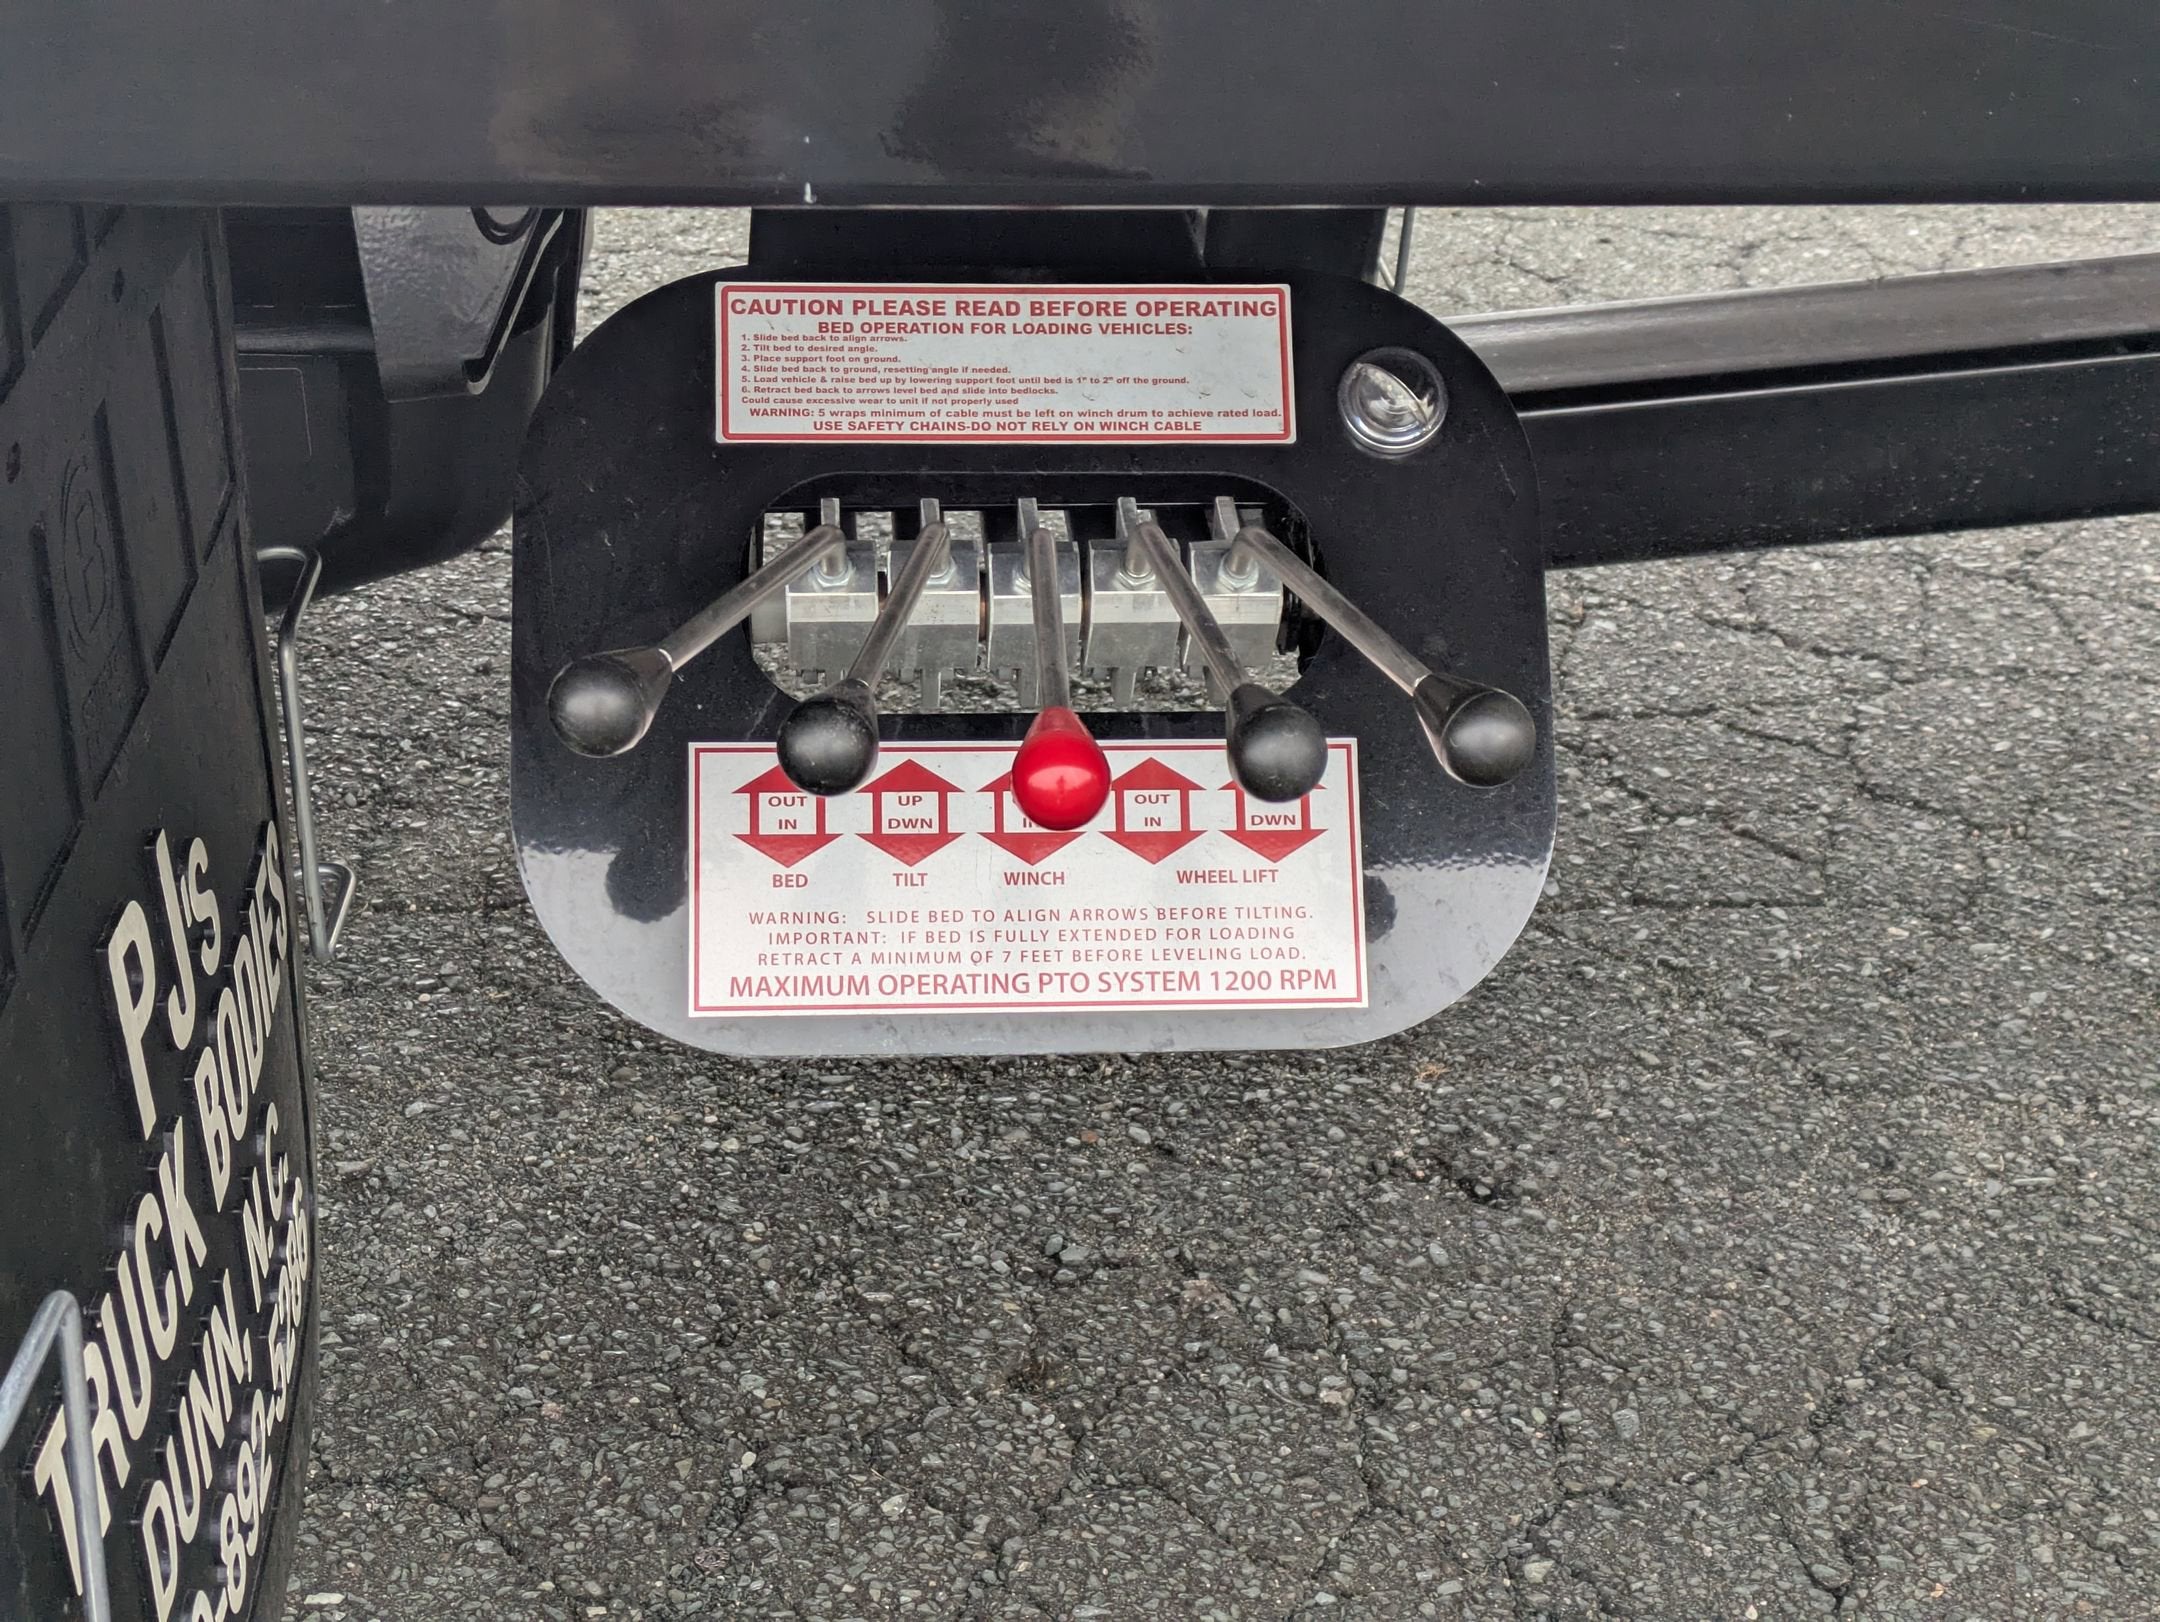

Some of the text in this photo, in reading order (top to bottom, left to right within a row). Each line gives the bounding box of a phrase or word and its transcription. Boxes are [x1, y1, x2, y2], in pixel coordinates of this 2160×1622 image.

[731, 299, 1275, 316] CAUTION PLEASE READ BEFORE OPERATING
[818, 322, 1192, 335] BED OPERATION FOR LOADING VEHICLES:
[932, 367, 958, 375] angle
[895, 377, 905, 385] by
[910, 377, 951, 385] lowering
[1151, 377, 1189, 385] ground.
[951, 398, 991, 406] properly
[749, 408, 813, 416] WARNING:
[930, 409, 940, 417] of
[1035, 409, 1054, 417] left
[1252, 409, 1281, 417] load.
[813, 421, 1201, 430] USE SAFETY CHAINS-DO NOT RELY ON WINCH CABLE
[768, 796, 808, 808] OUT
[898, 795, 922, 807] UP
[1134, 794, 1170, 804] OUT
[778, 818, 798, 830] IN
[888, 818, 933, 830] DWN
[1144, 816, 1162, 827] IN
[1251, 815, 1296, 826] DWN
[772, 873, 808, 888] BED
[892, 872, 928, 886] TILT
[1003, 871, 1064, 885] WINCH
[1176, 869, 1279, 884] WHEEL LIFT
[748, 906, 1312, 924] WARNING: SLIDE BED TO ALIGN ARROWS BEFORE TILTING.
[769, 926, 1294, 944] IMPORTANT: IF BED IS FULLY EXTENDED FOR LOADING
[758, 946, 1305, 966] RETRACT A MINIMUM OF 7 FEET BEFORE LEVELING LOAD.
[108, 828, 221, 1141] PJ's
[729, 968, 1336, 997] MAXIMUM OPERATING PTO SYSTEM 1200 RPM
[34, 820, 287, 1597] TRUCK BODIES
[142, 1268, 252, 1622] DUNN,
